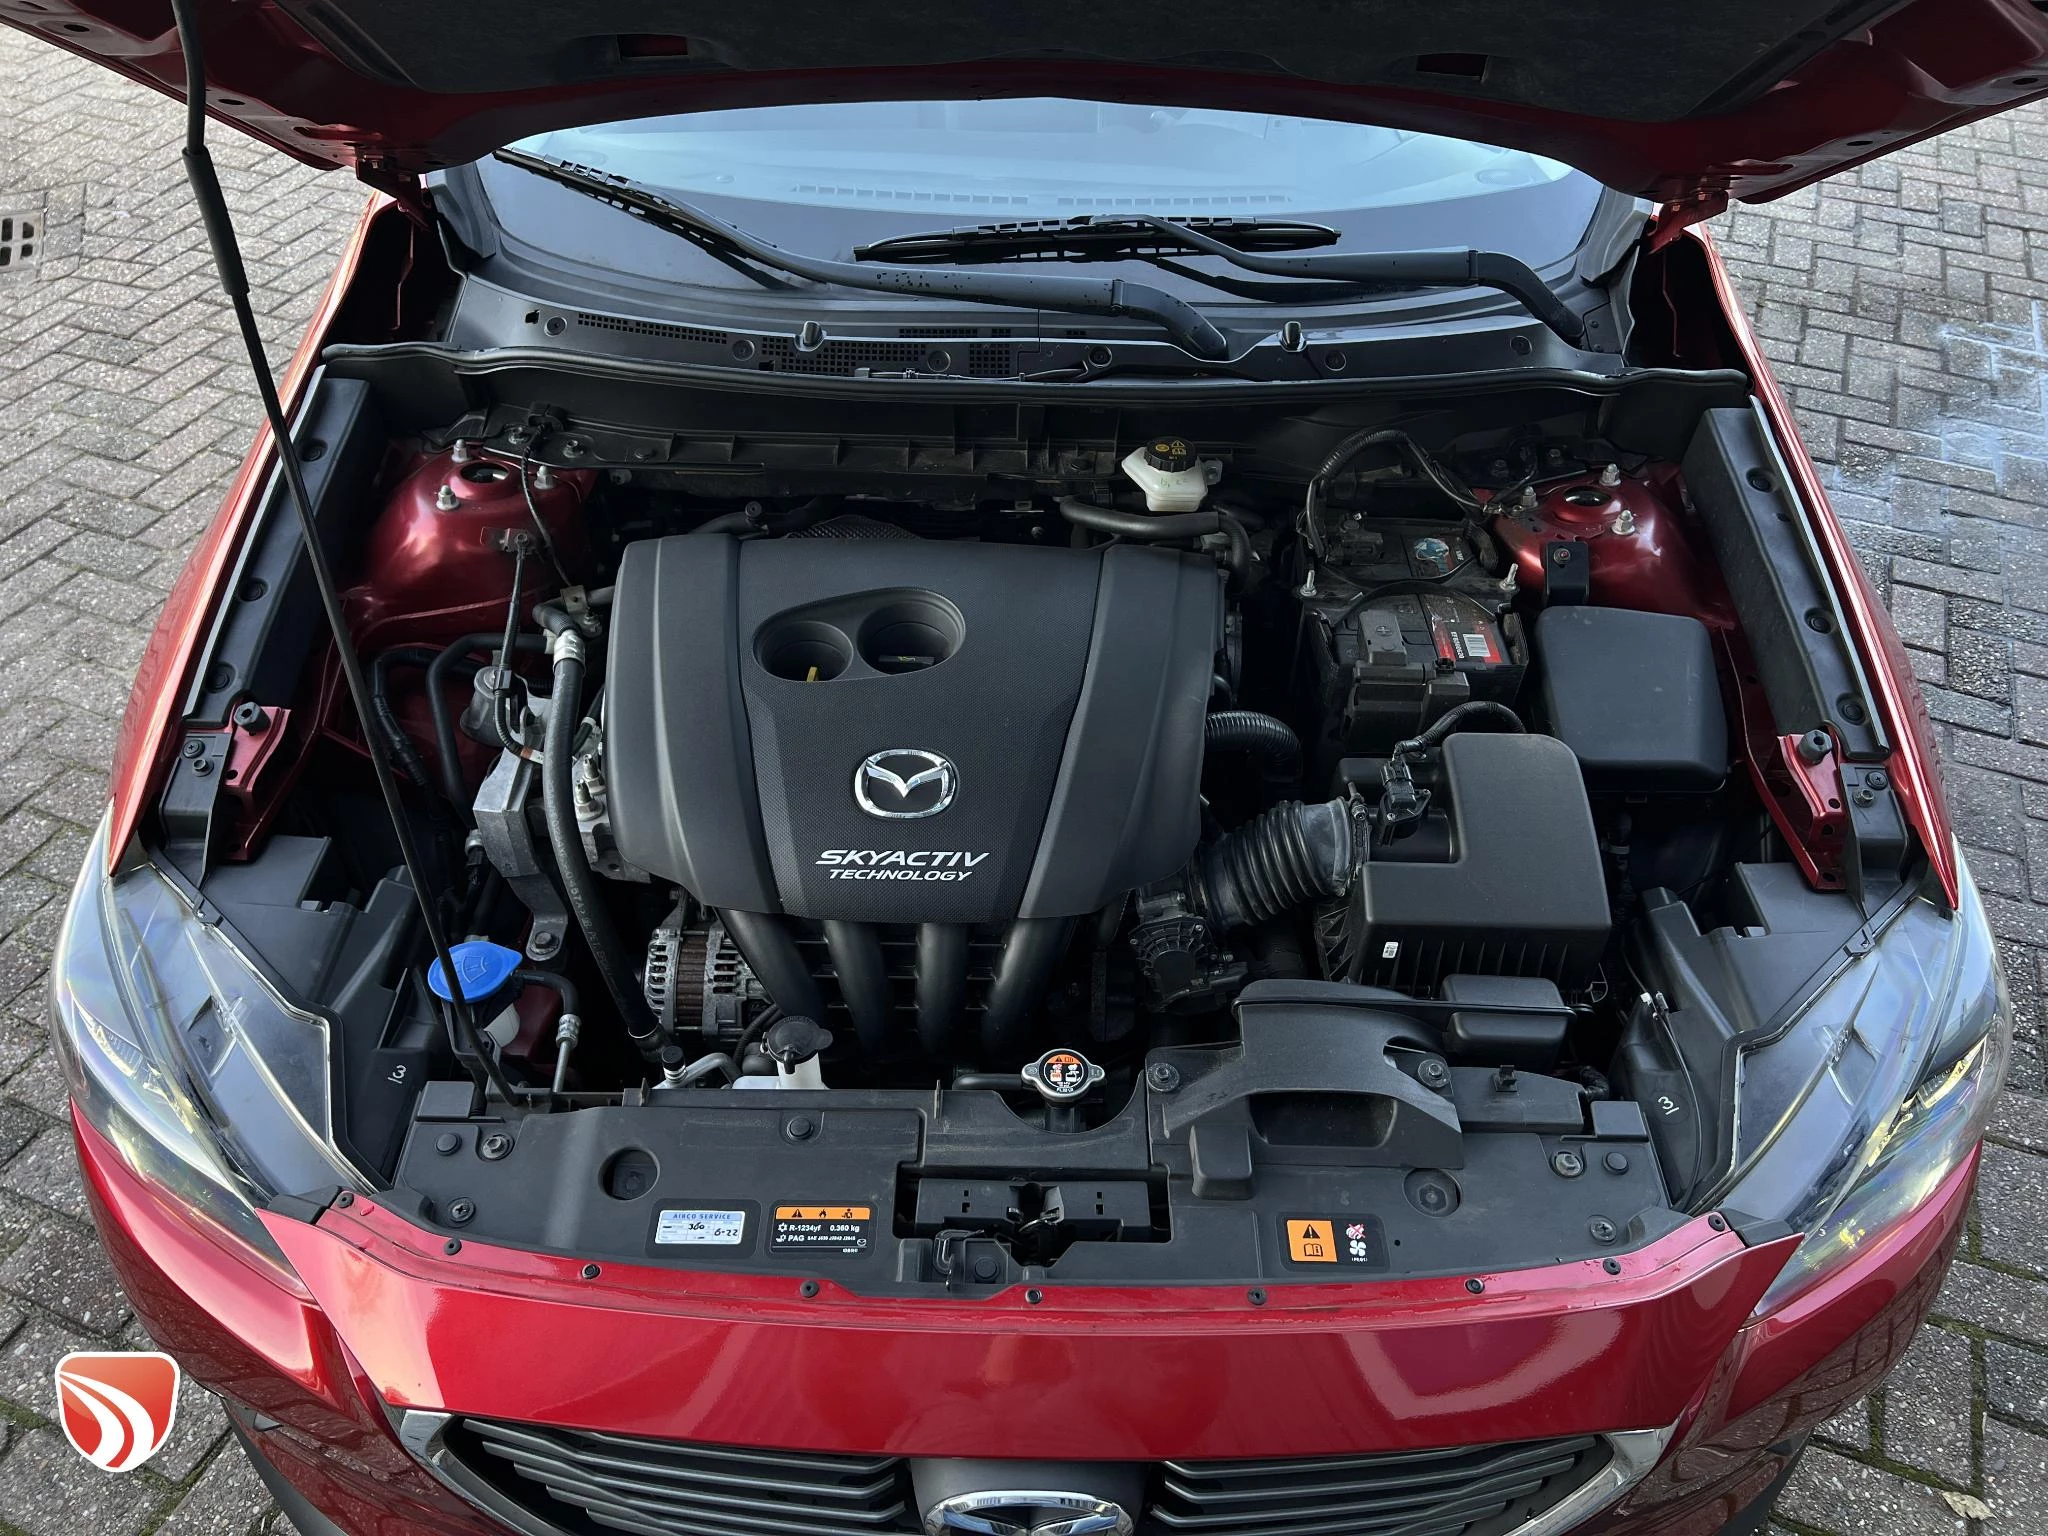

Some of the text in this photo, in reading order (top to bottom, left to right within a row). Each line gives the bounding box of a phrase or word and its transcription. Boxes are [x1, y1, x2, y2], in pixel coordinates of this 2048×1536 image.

[815, 850, 990, 867] SKYACTIV
[829, 869, 973, 881] TECHNOLOGY
[714, 1228, 738, 1237] 6-22
[788, 1224, 822, 1233] R-1234yf
[850, 1224, 860, 1233] kg
[787, 1234, 805, 1242] PAG
